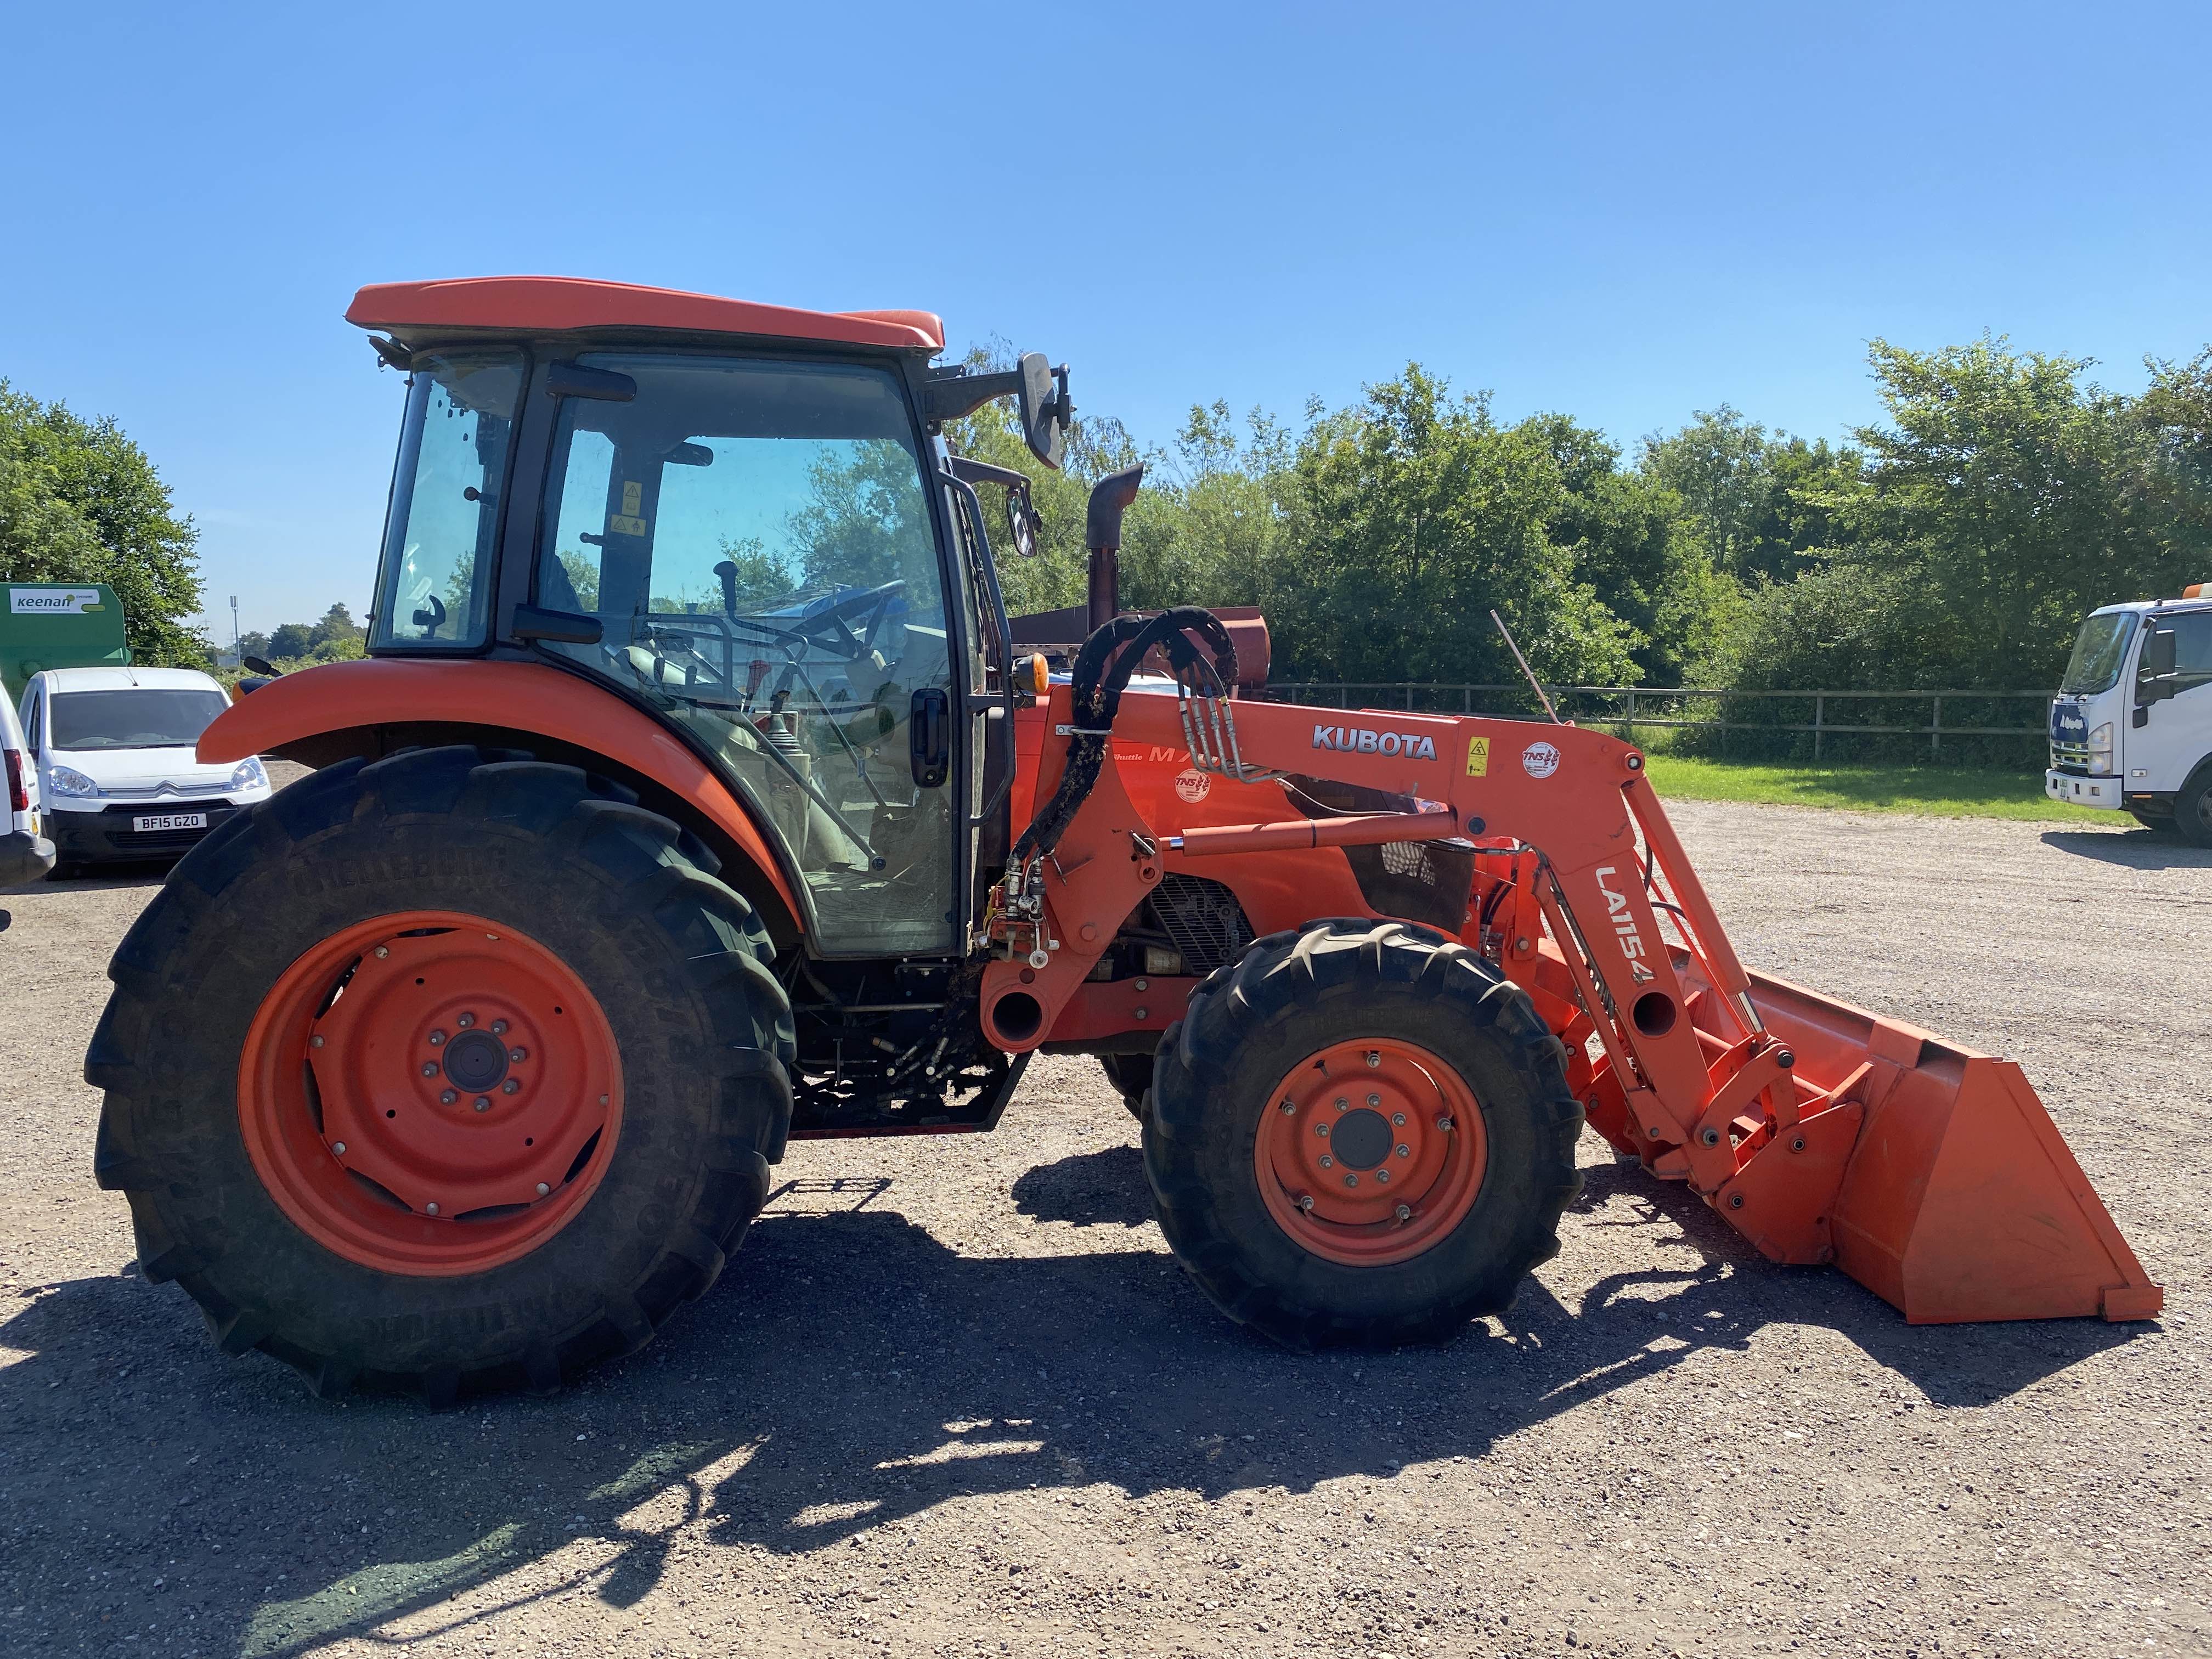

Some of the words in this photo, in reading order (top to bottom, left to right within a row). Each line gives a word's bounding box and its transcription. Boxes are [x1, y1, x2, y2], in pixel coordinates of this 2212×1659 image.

[1312, 724, 1437, 761] KUBOTA
[1523, 752, 1545, 760] TNS
[1176, 778, 1197, 786] TNS
[142, 817, 170, 828] BF15
[174, 816, 198, 827] GZO
